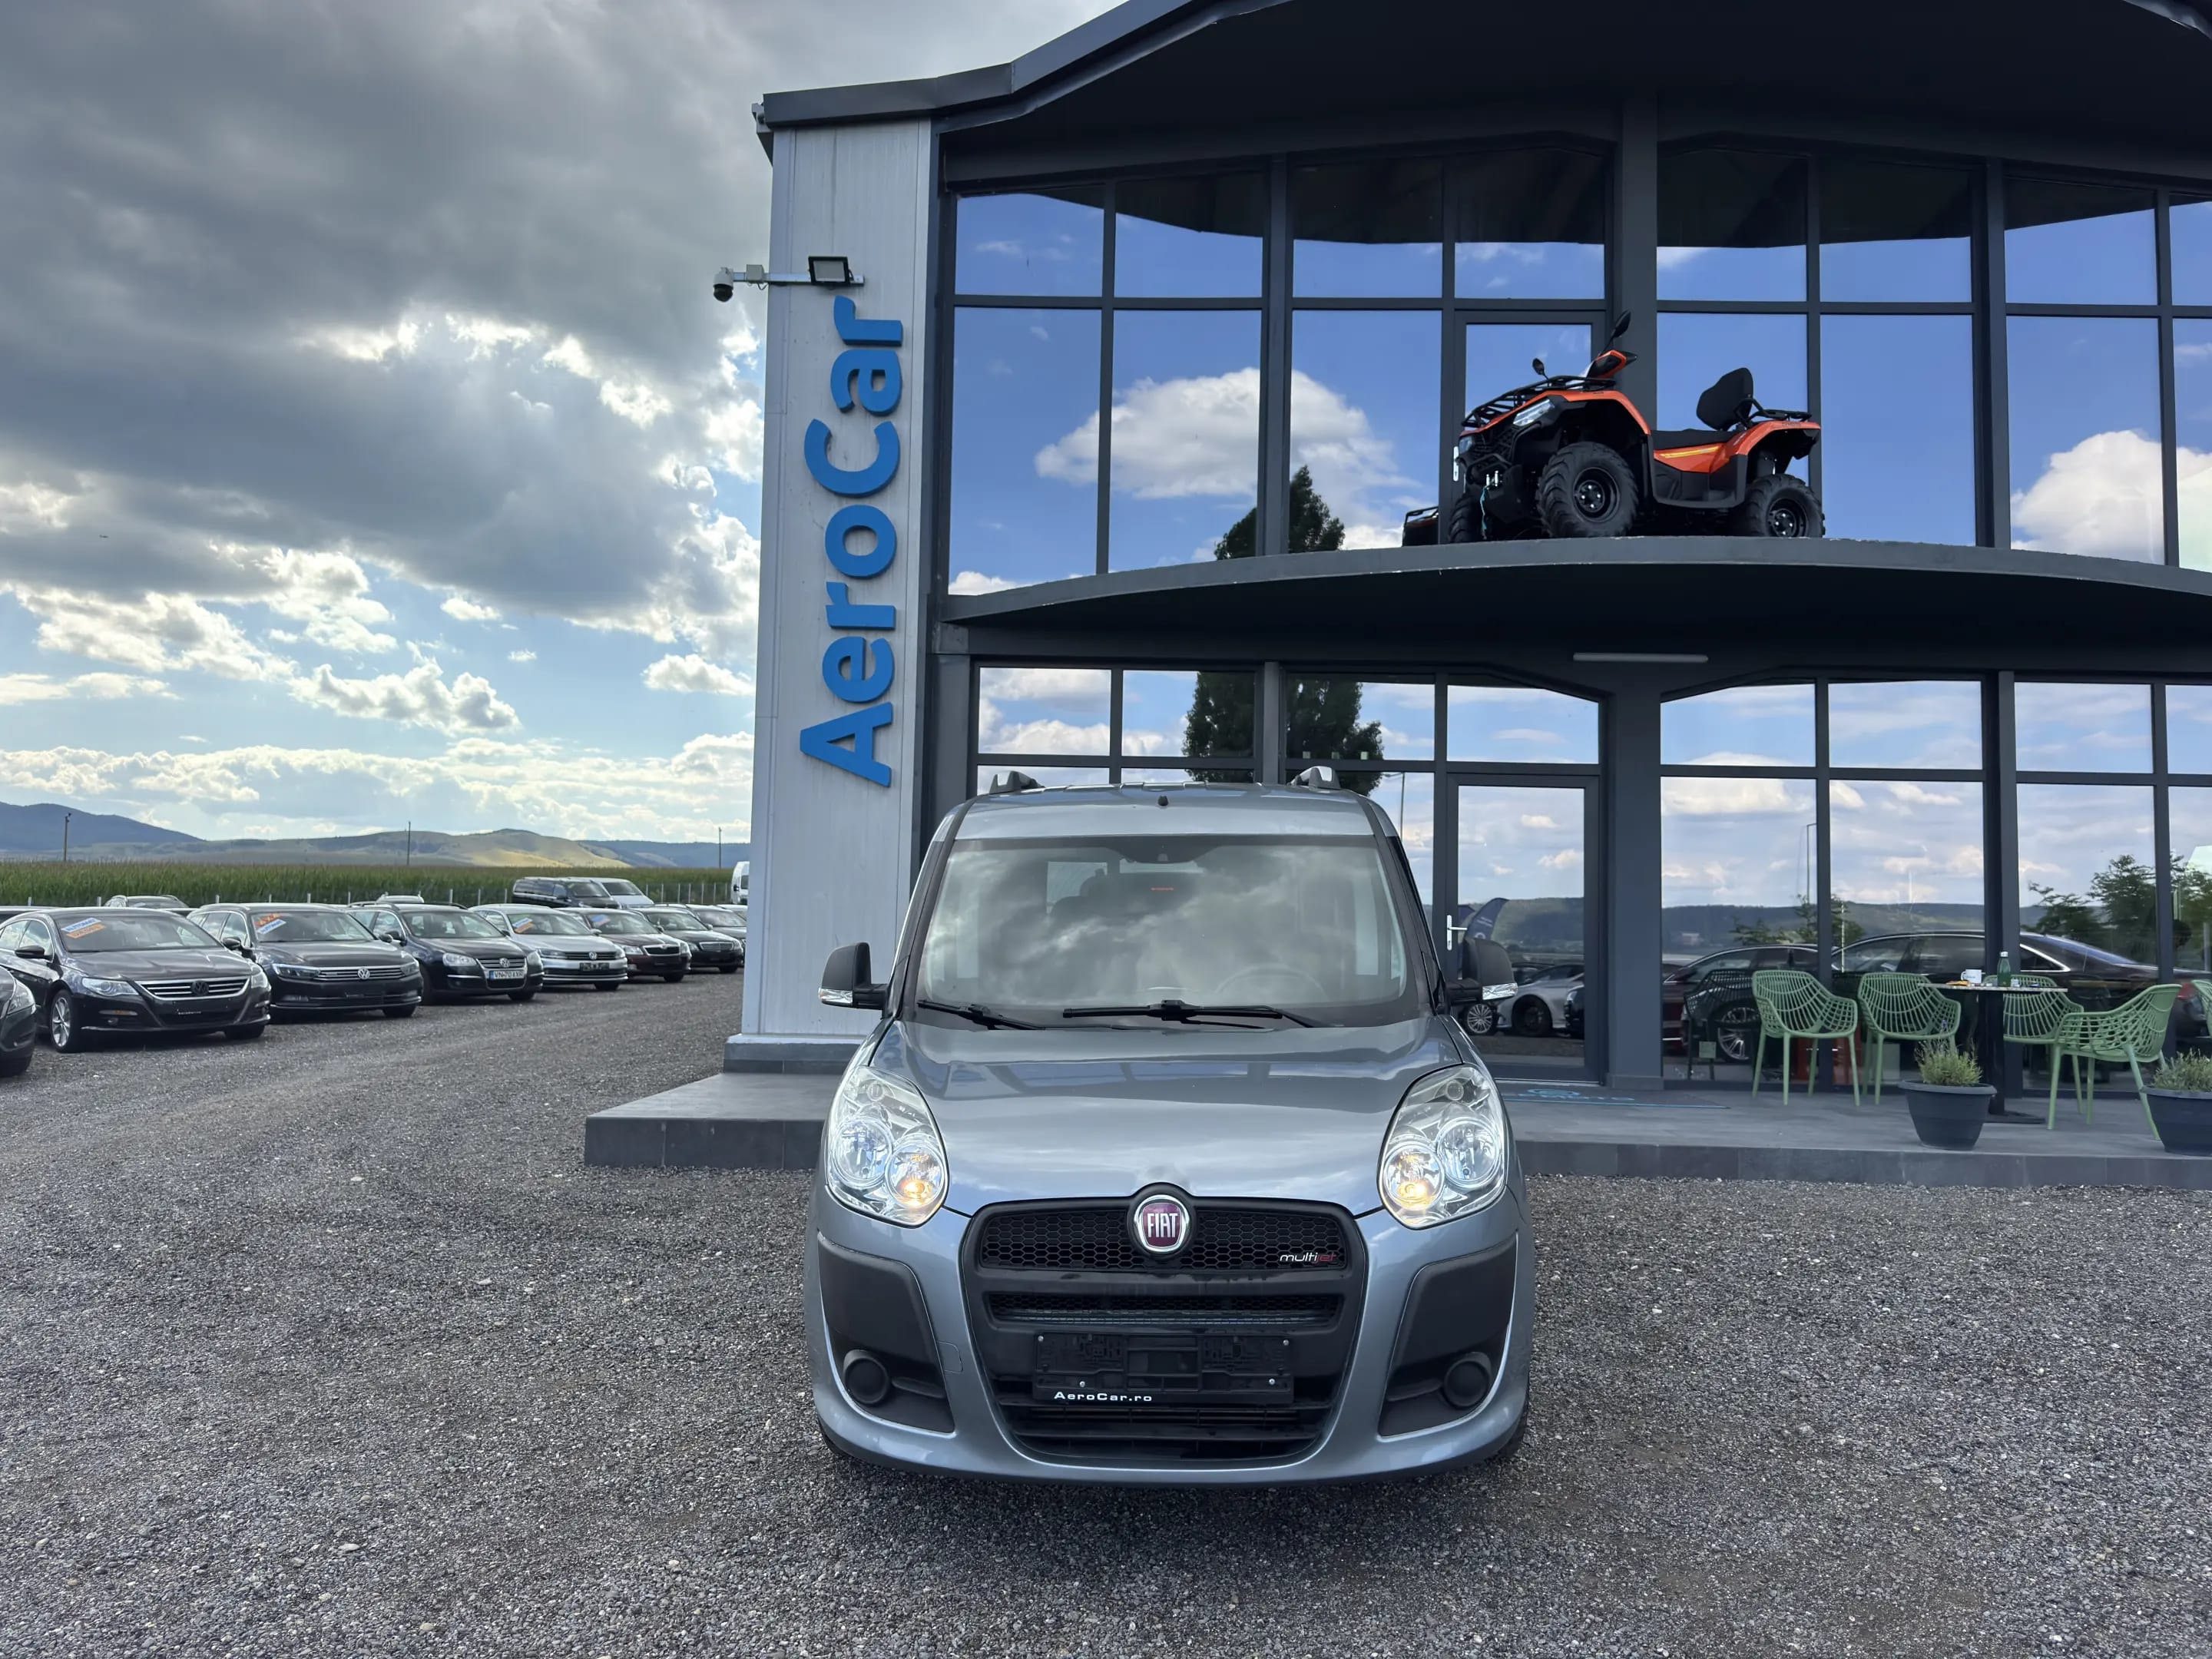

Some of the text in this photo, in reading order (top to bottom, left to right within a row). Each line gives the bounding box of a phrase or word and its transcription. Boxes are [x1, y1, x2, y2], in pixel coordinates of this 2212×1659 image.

[800, 295, 903, 788] AeroCar
[1147, 1213, 1178, 1237] FIAT
[1280, 1252, 1337, 1264] multijet
[1054, 1391, 1152, 1402] AeroCar.ro
